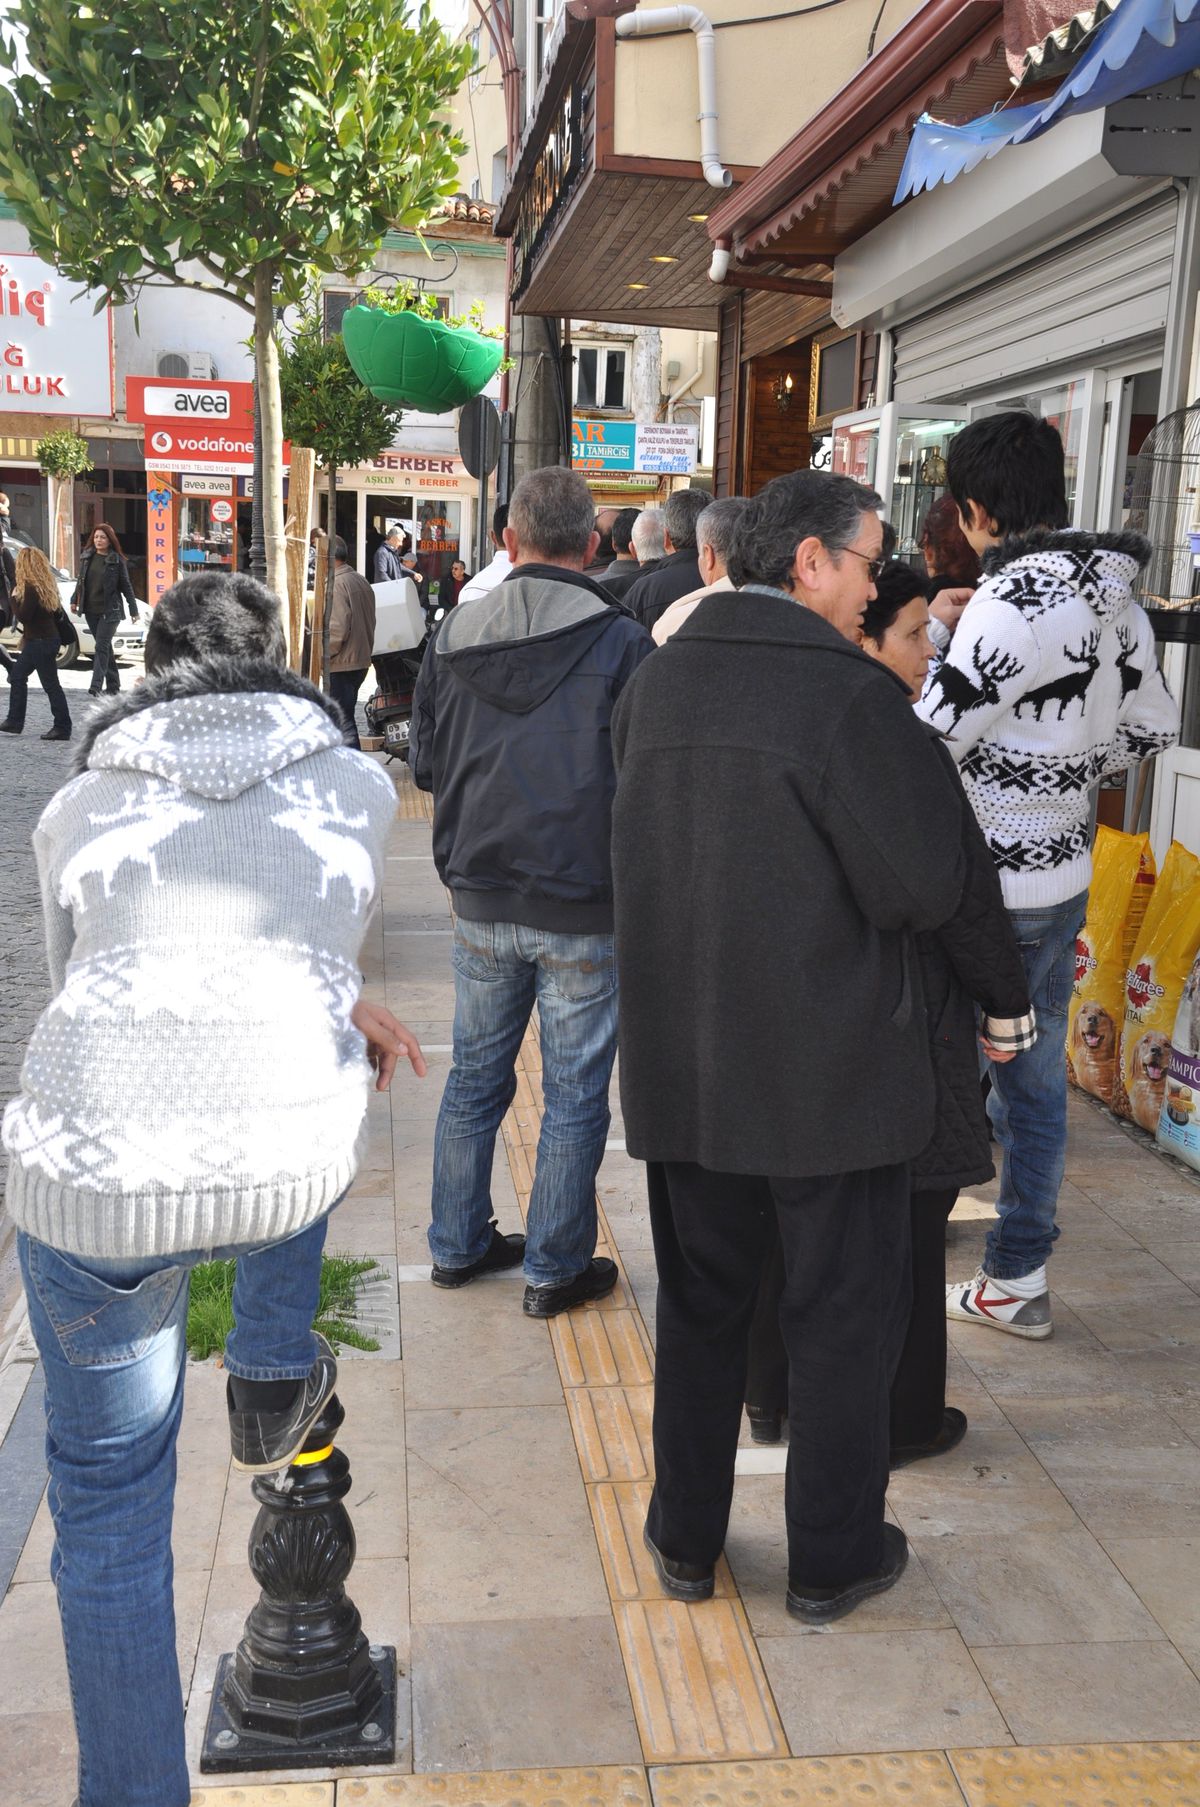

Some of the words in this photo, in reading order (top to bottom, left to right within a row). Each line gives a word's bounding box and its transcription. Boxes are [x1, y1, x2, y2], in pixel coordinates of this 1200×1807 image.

[0, 374, 66, 397] LUK
[174, 393, 228, 413] avea
[178, 436, 254, 453] vodafone
[373, 455, 454, 474] BERBER
[184, 481, 206, 490] avea
[209, 482, 231, 491] avea
[365, 476, 395, 485] AŞKIN
[419, 479, 458, 487] BERBER
[389, 724, 400, 732] 09
